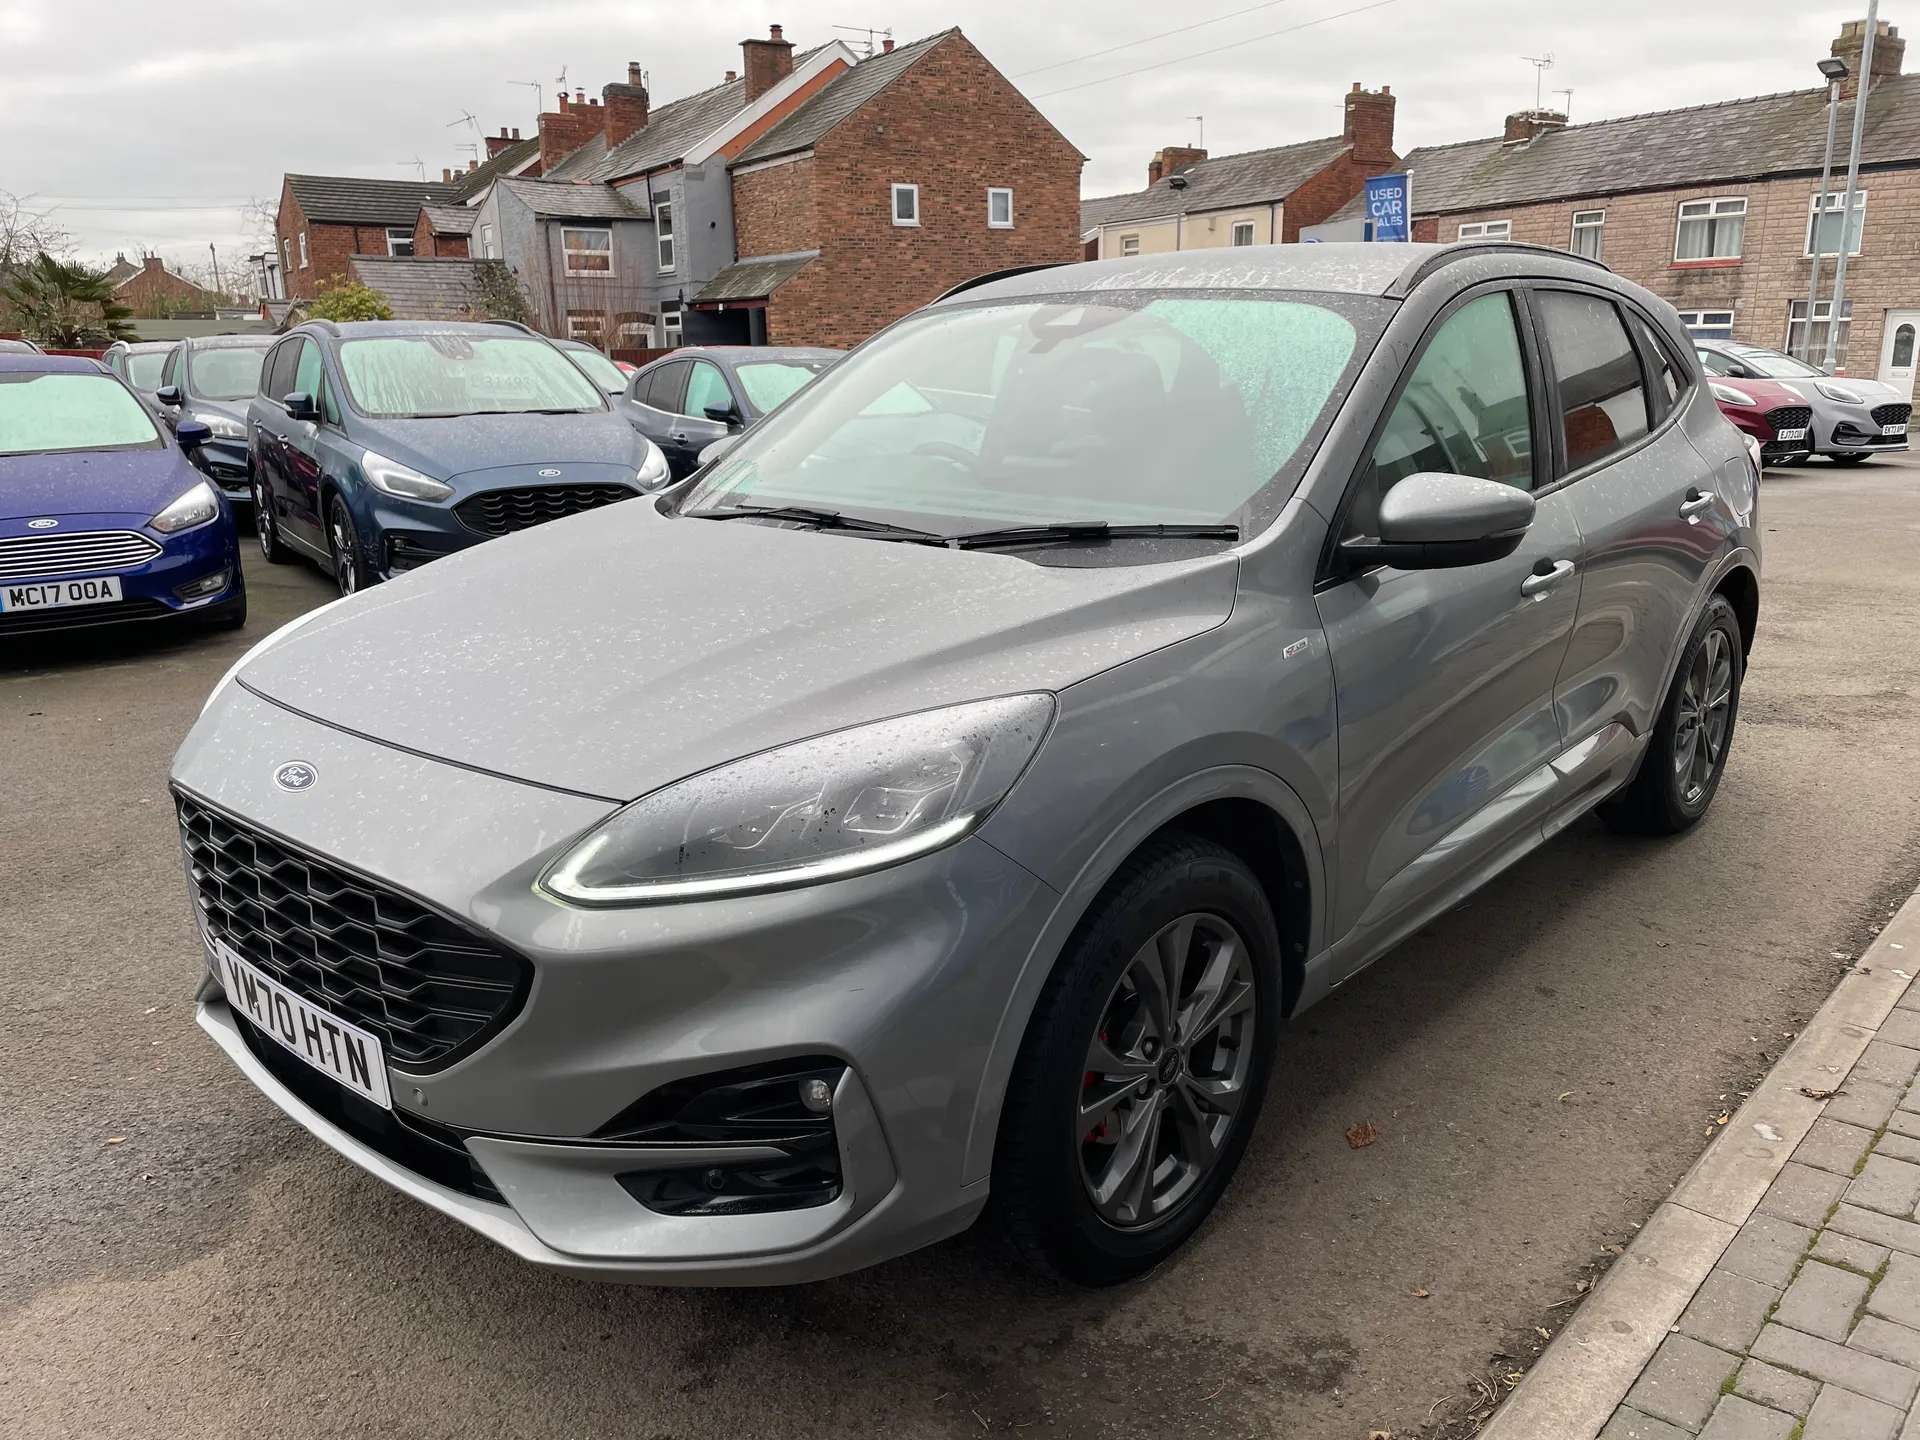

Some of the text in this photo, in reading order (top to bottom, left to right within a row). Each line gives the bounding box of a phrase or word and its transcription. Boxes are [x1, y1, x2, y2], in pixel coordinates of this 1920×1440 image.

[1370, 187, 1402, 201] USED
[1371, 200, 1402, 216] CAR
[1376, 215, 1403, 227] ALES
[9, 585, 61, 607] MC17
[225, 954, 373, 1092] YM70 HTN
